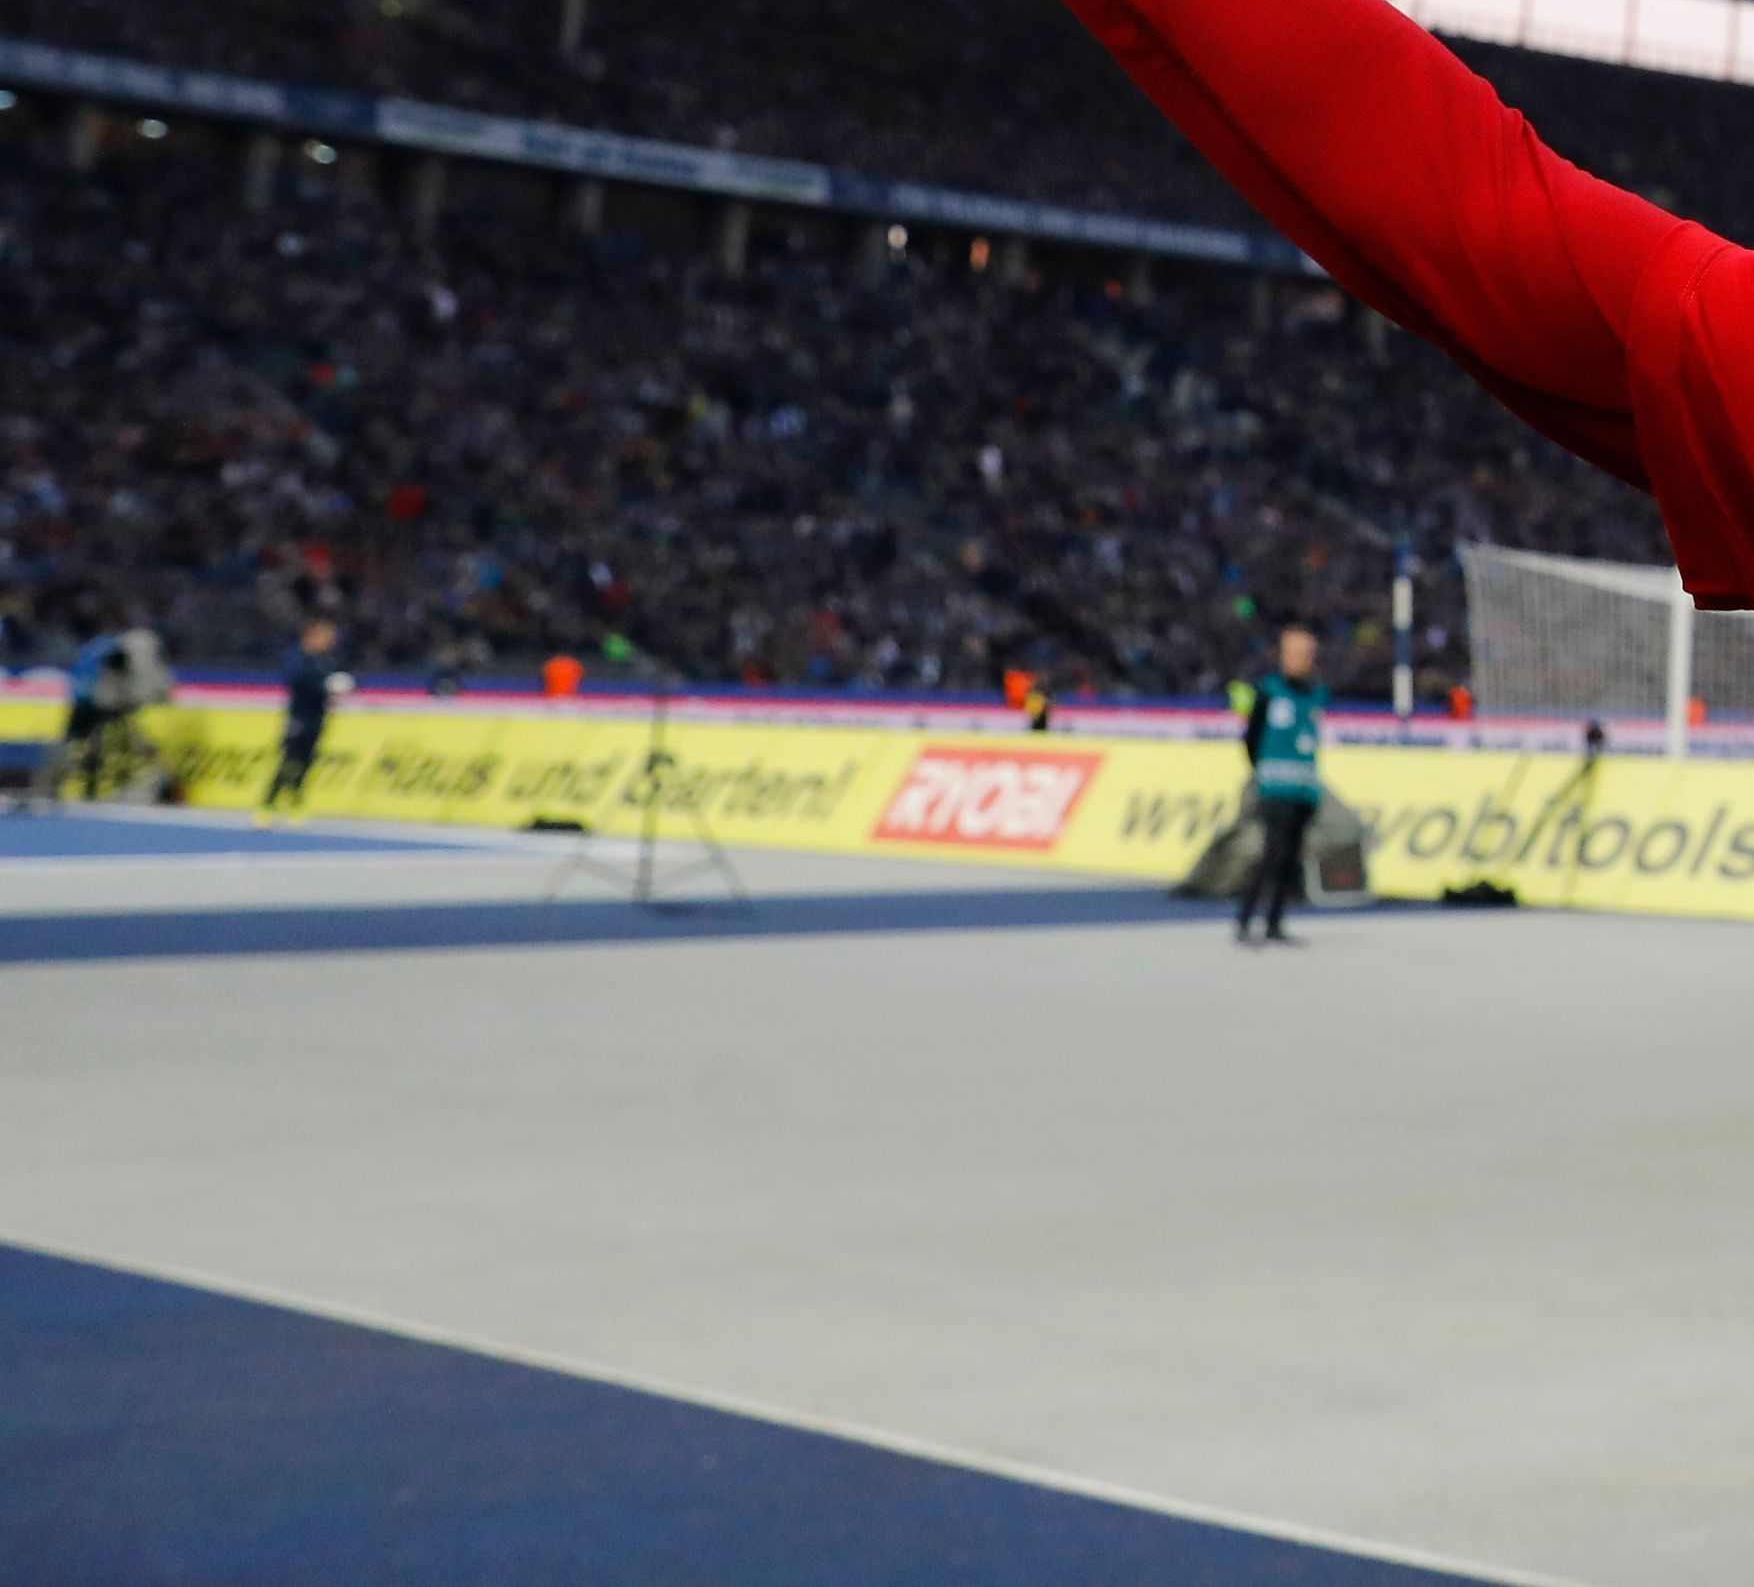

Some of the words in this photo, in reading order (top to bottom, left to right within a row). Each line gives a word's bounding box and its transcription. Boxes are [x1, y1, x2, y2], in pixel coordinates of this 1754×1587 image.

[362, 739, 502, 800] Haus
[503, 747, 626, 805] und
[884, 759, 1084, 838] RYOBI
